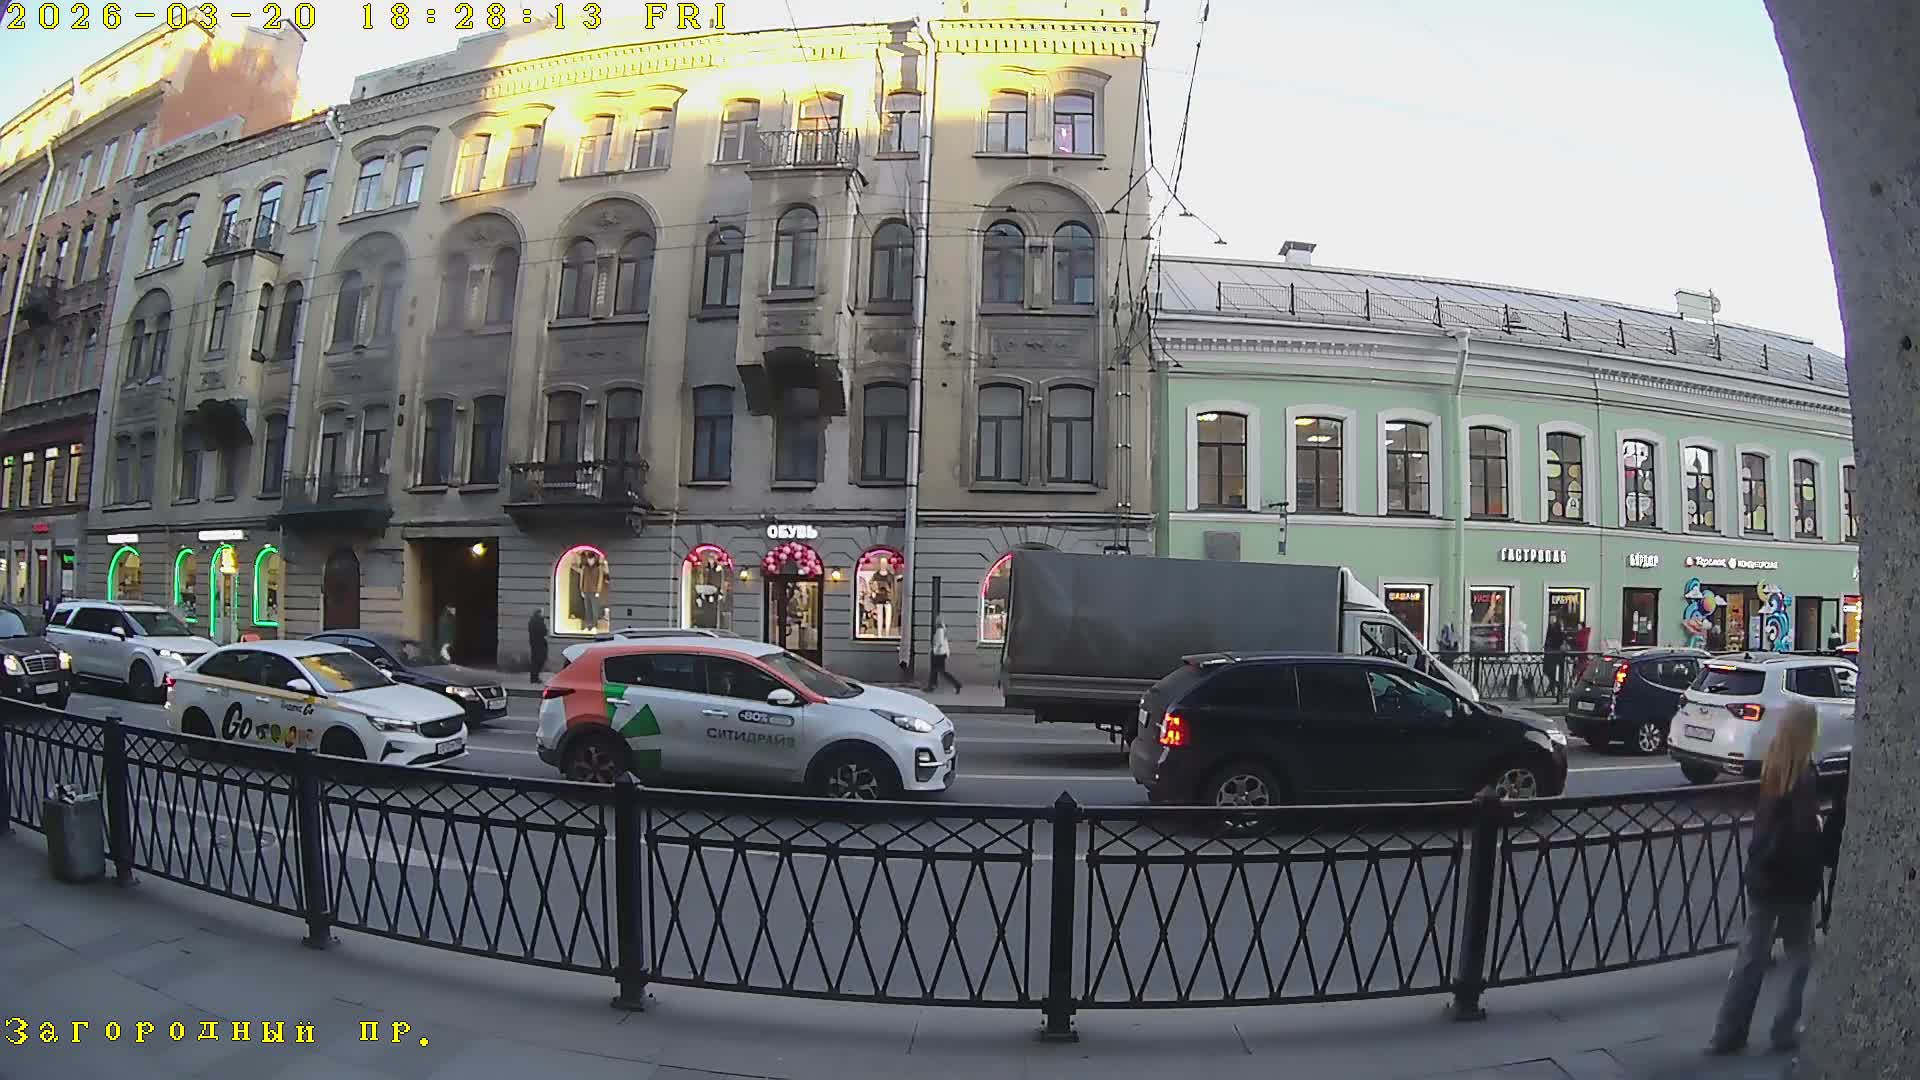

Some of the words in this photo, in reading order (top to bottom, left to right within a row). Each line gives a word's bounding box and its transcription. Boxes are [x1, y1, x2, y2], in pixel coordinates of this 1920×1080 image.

[767, 525, 818, 539] ОБУВЬ
[1501, 548, 1567, 563] ГАСТРОПАБ
[221, 701, 253, 740] Go
[706, 727, 796, 747] СИТИДРАЙВ
